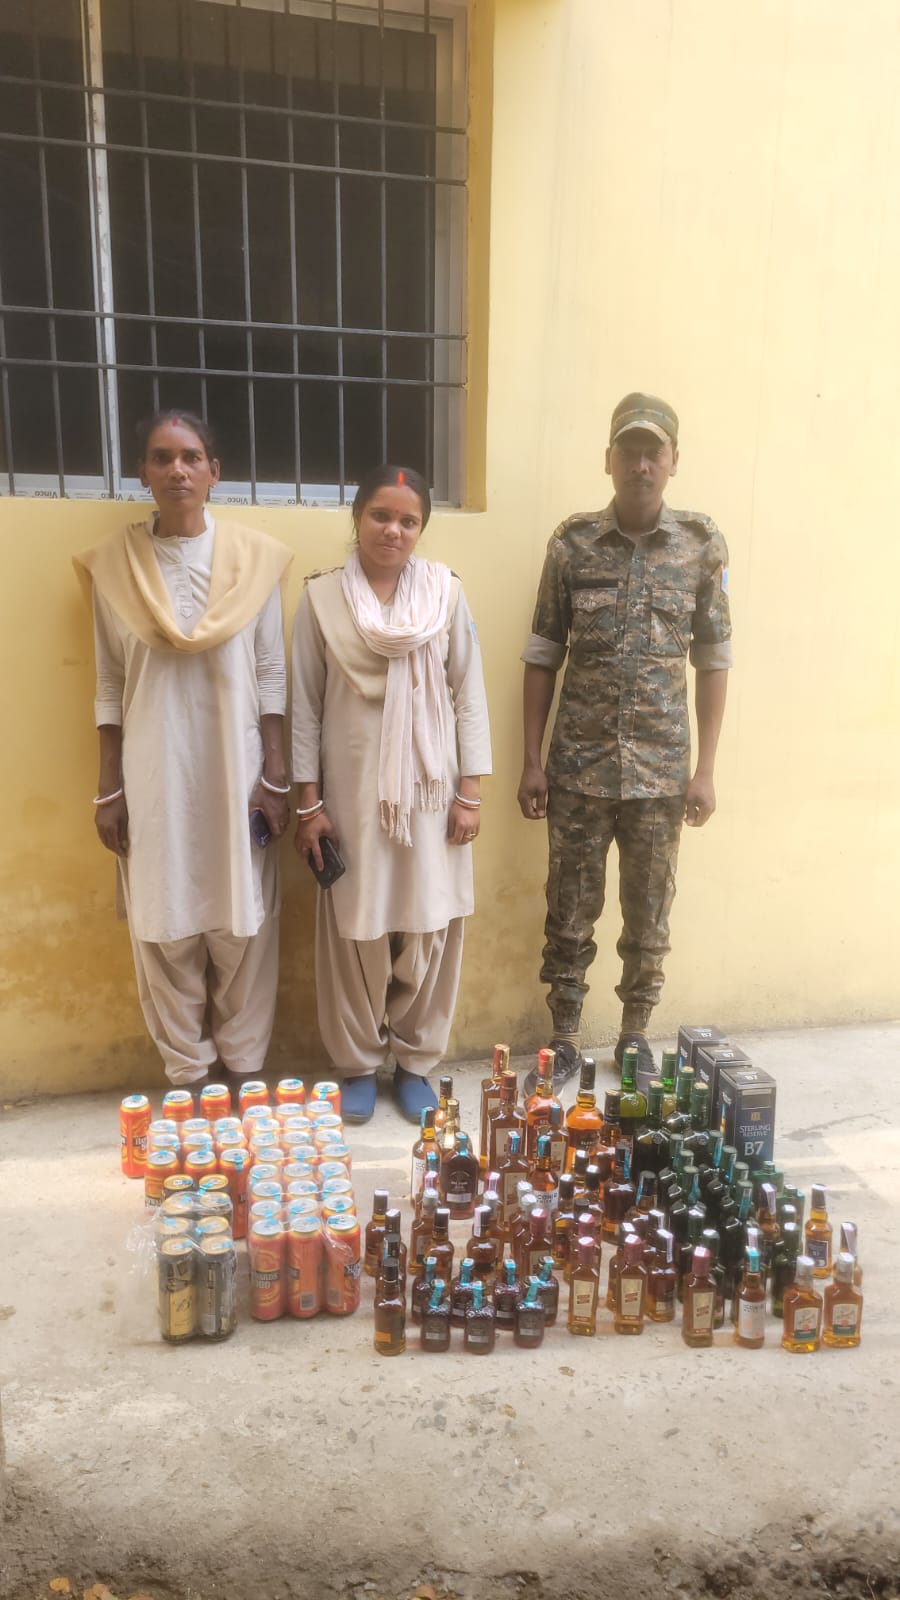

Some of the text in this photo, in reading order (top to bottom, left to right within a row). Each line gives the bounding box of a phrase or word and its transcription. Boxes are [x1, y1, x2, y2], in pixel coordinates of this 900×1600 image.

[34, 490, 58, 499] Vinco
[227, 497, 248, 505] Vinco
[743, 1140, 765, 1156] B7
